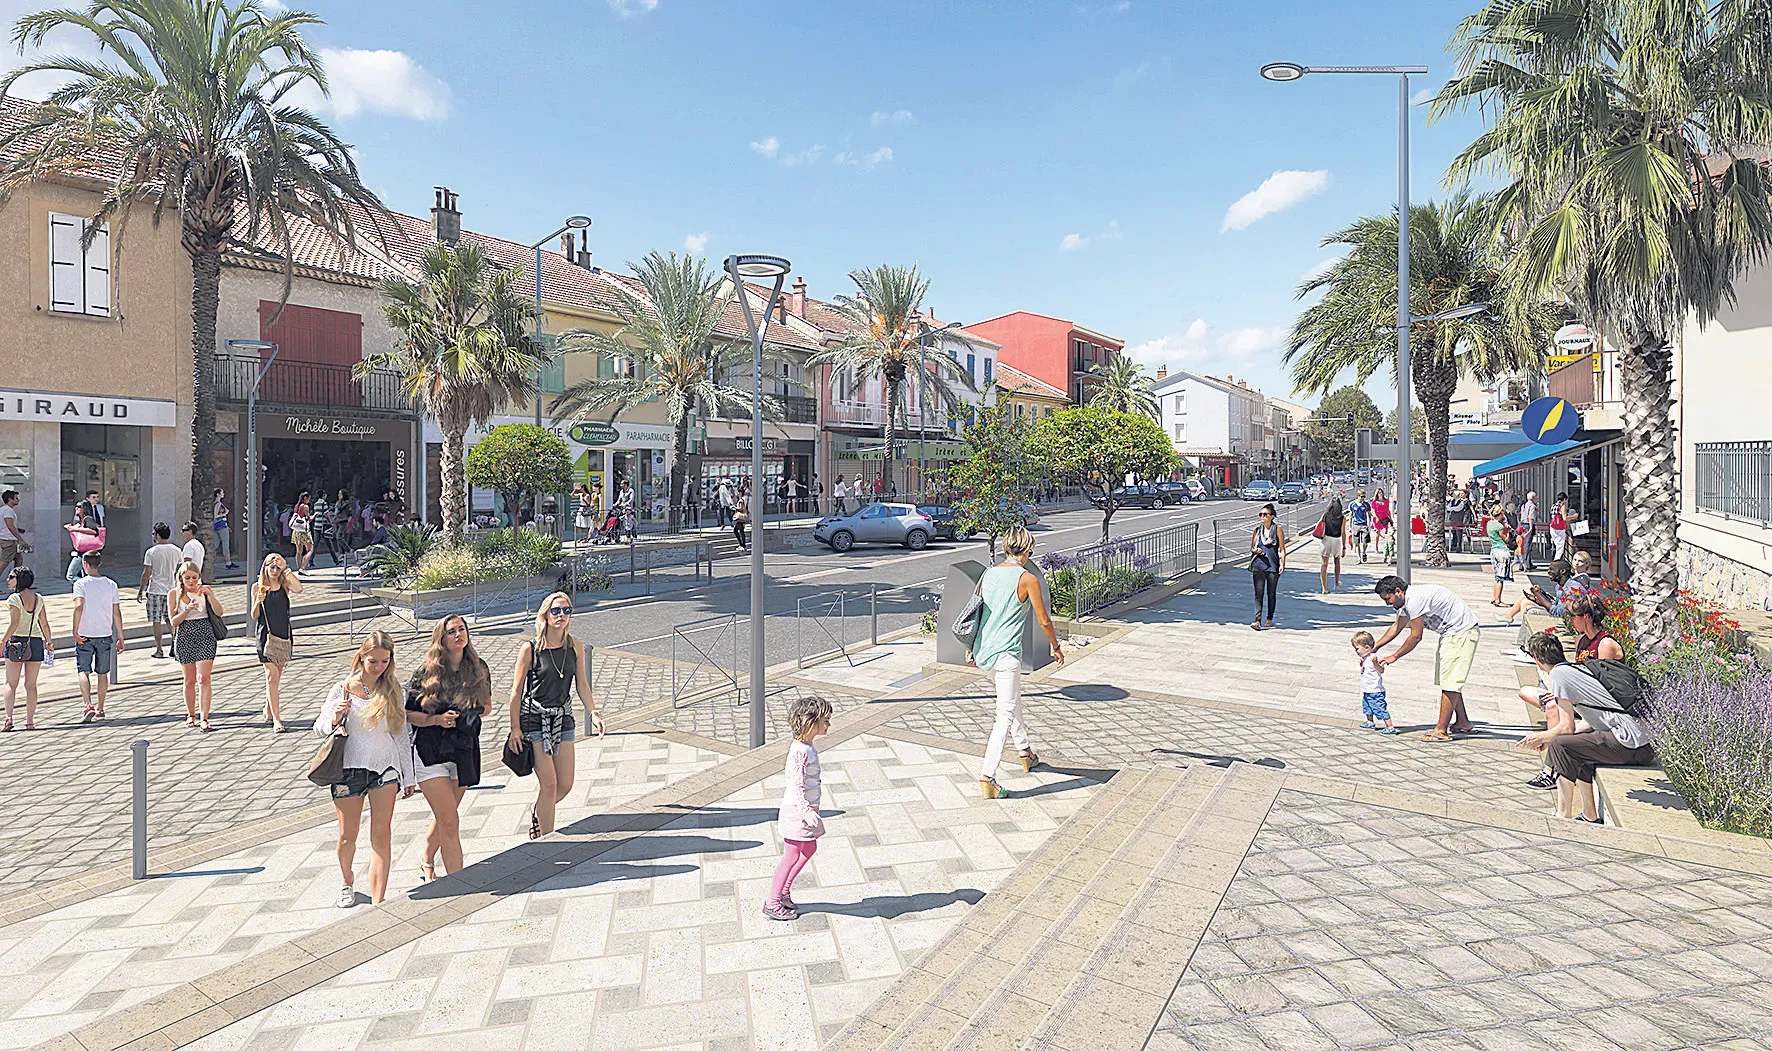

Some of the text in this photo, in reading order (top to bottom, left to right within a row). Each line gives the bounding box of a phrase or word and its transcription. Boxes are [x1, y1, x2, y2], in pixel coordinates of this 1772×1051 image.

[1558, 337, 1590, 345] JOURNAUX
[285, 416, 376, 440] Michèle Boutique
[583, 426, 614, 434] PHARMACIE
[626, 431, 670, 442] PARAPHARMACIE
